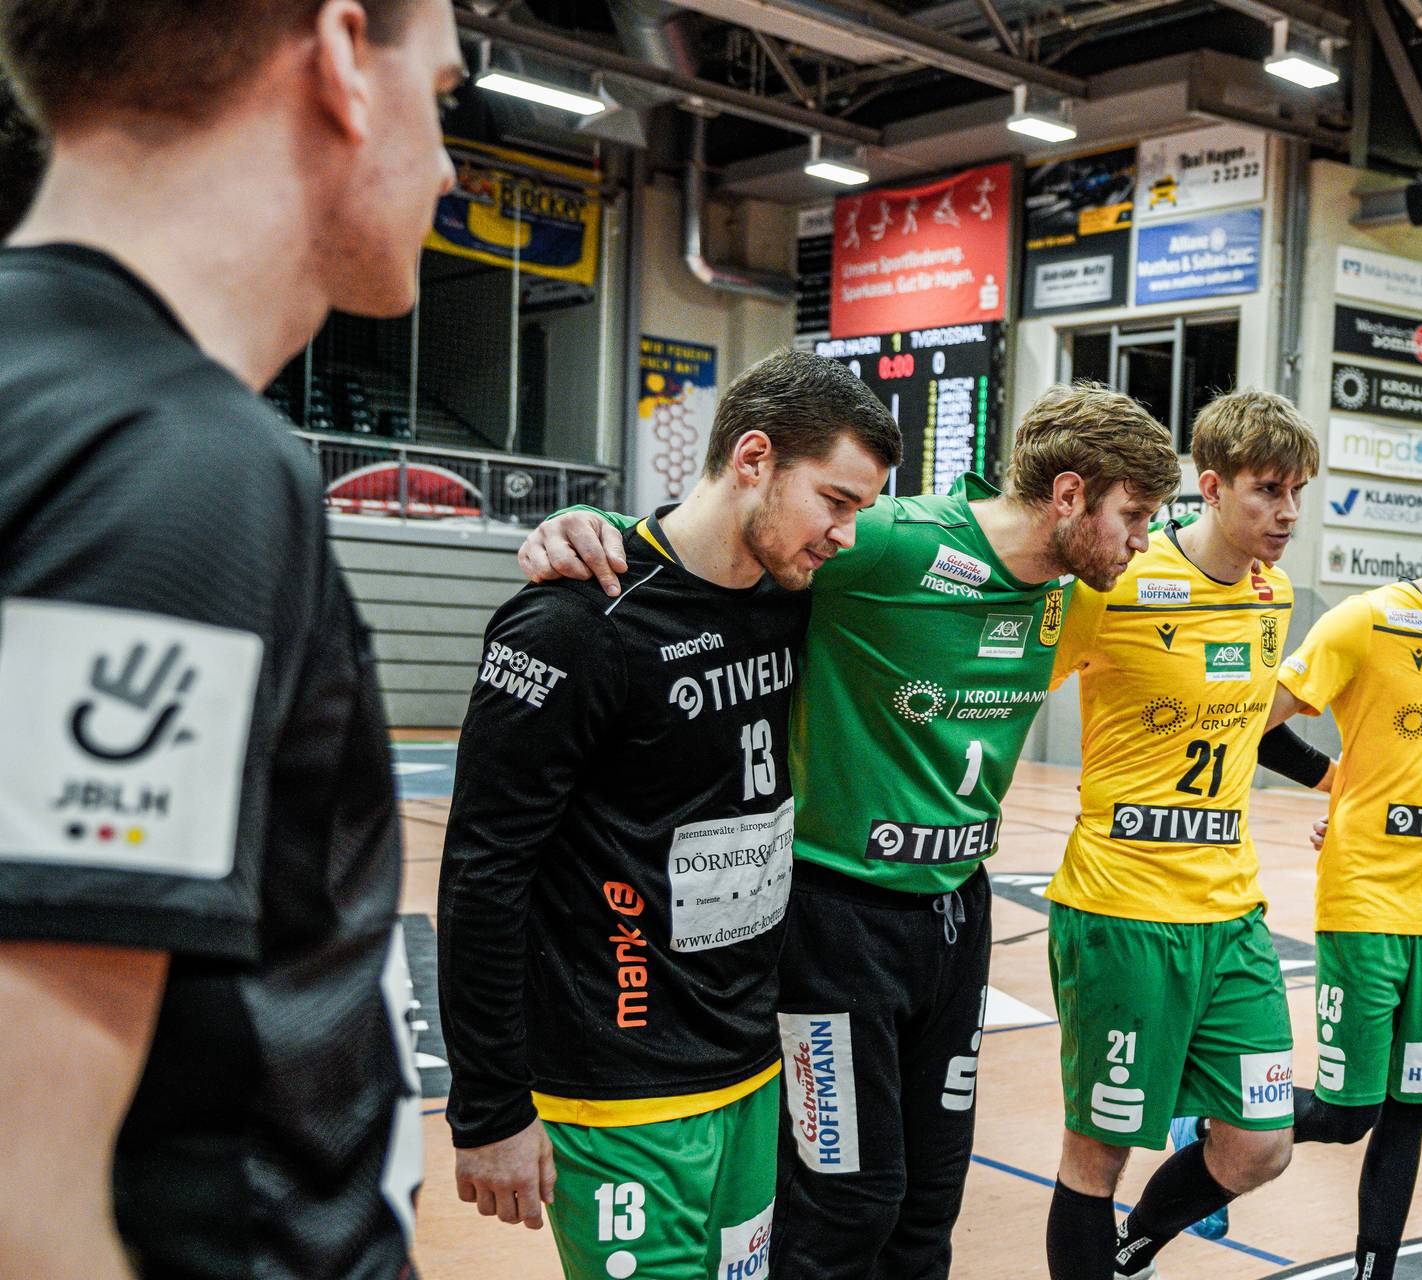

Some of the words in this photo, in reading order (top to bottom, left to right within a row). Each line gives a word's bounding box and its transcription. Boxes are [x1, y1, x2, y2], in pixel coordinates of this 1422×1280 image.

[1206, 147, 1247, 163] Hagen
[935, 559, 986, 584] HOFFMANN
[947, 554, 982, 575] Getränke
[920, 574, 985, 600] macron
[1140, 590, 1190, 600] HOFFMANN
[990, 620, 1023, 637] AOK
[660, 631, 725, 662] macron
[1213, 646, 1245, 662] AOK
[479, 662, 550, 708] DUWE
[704, 647, 794, 711] TIVELA
[964, 688, 1049, 704] KROLLMANN
[955, 707, 1013, 721] GRUPPE
[740, 718, 776, 801] 13
[955, 740, 983, 796] 1
[1176, 739, 1228, 798] 21
[678, 825, 735, 840] Patentanwälte
[1150, 808, 1241, 841] TIVELA
[1317, 982, 1345, 1025] 43
[1106, 1029, 1138, 1065] 21
[796, 1041, 819, 1144] Getränke
[811, 1019, 841, 1166] HOFFMANN
[1249, 1082, 1294, 1104] HOFF
[593, 1180, 647, 1243] 13
